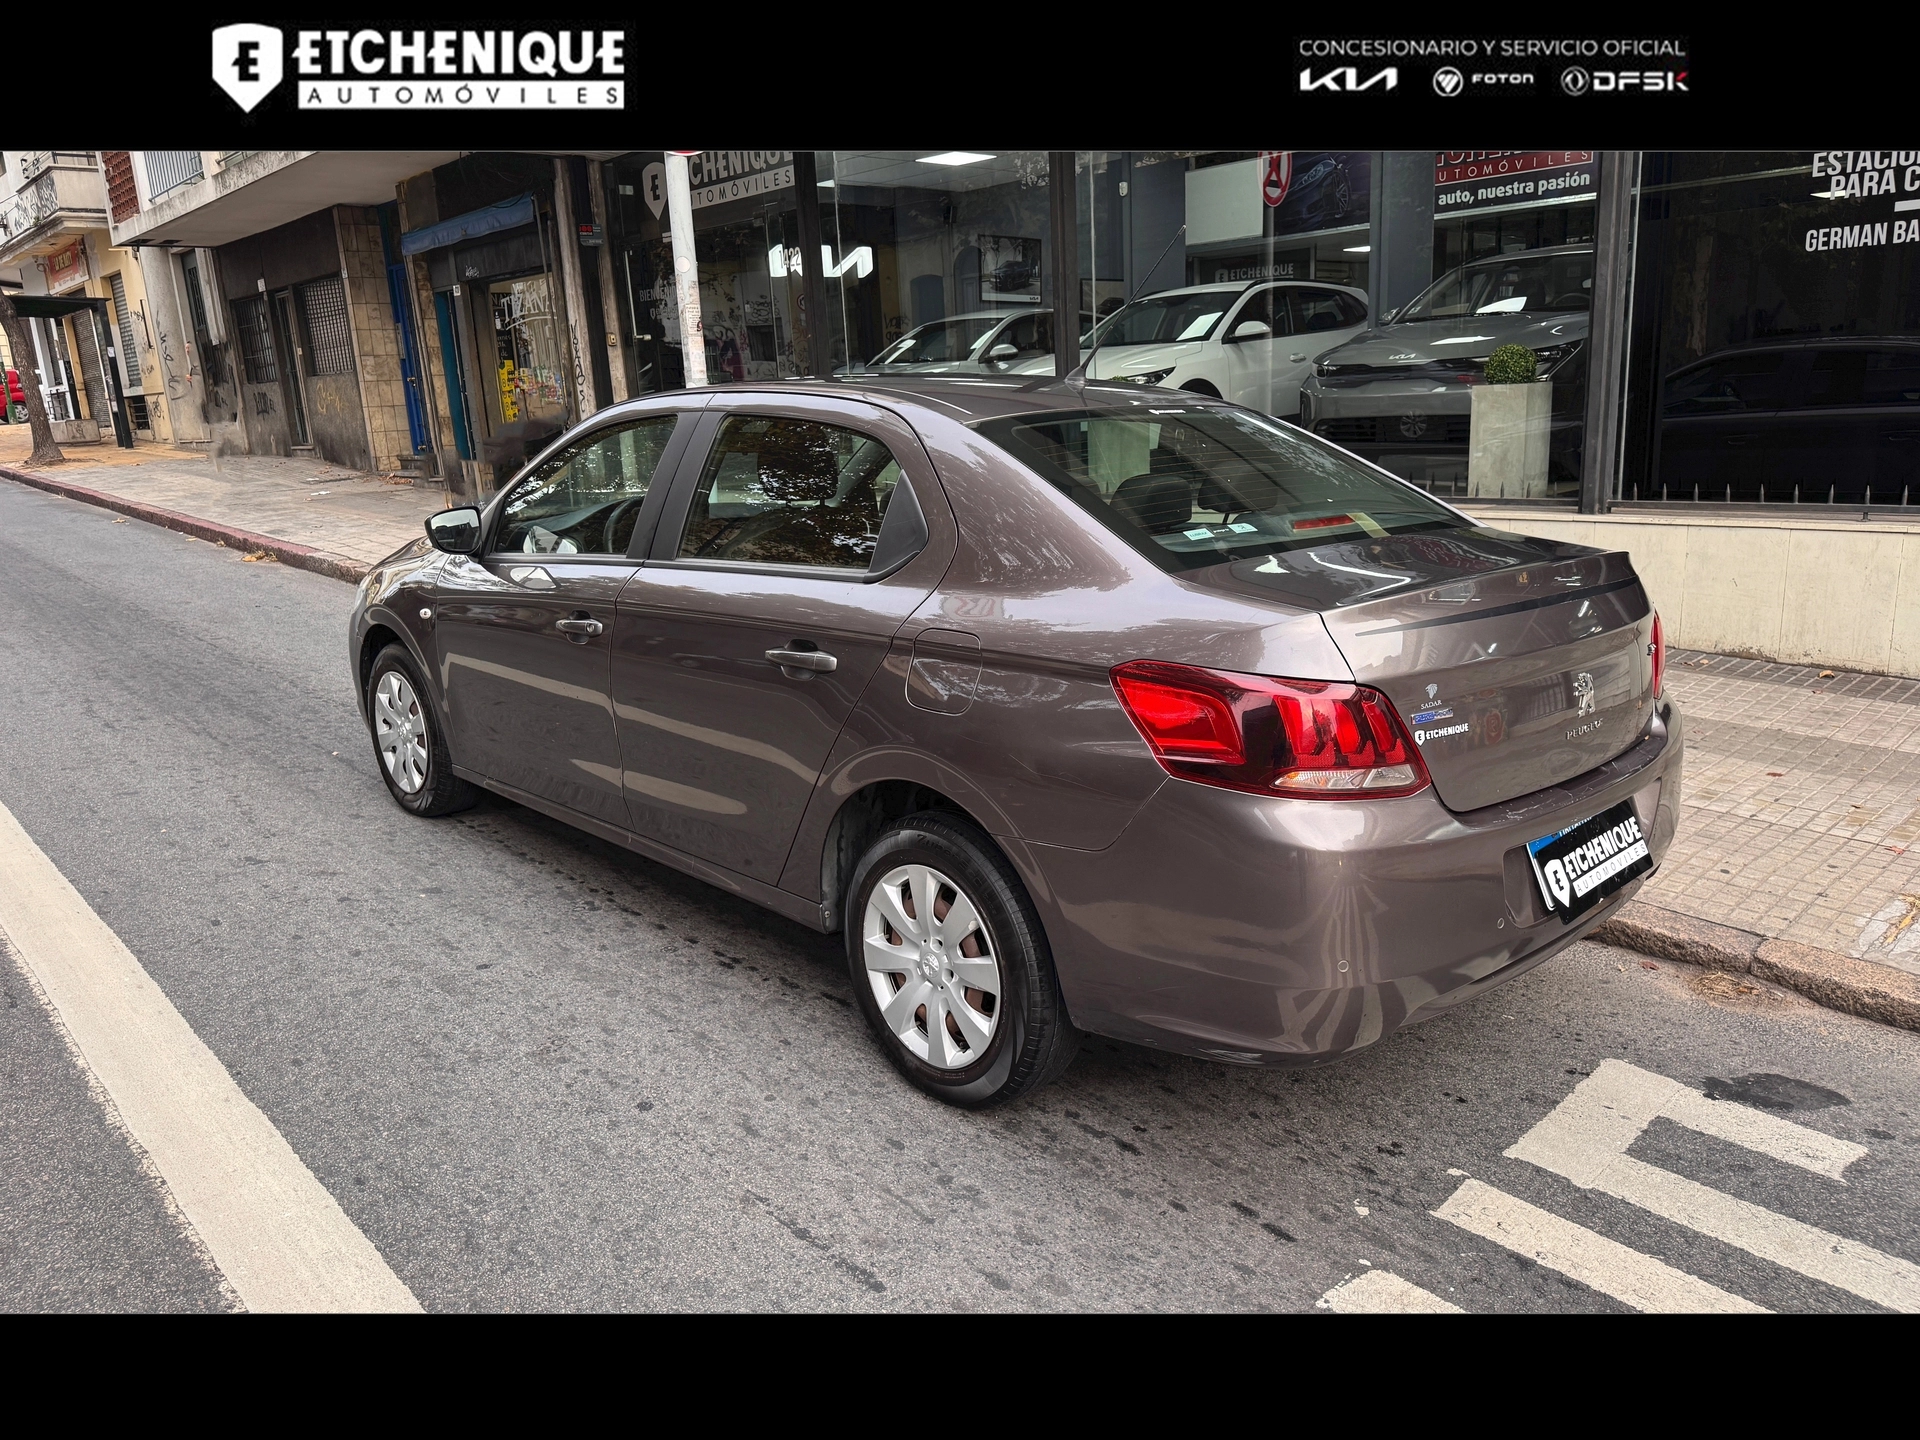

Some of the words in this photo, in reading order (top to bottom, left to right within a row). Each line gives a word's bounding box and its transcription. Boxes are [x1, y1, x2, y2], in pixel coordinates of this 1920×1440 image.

[1437, 151, 1589, 182] UTOMÓVILES
[1811, 151, 1920, 178] ESTACIO
[690, 169, 792, 206] TOMÓVILES
[1438, 189, 1475, 206] auto,
[1478, 181, 1535, 200] nuestra
[1538, 171, 1590, 196] pasión
[1829, 168, 1897, 200] PARA
[1805, 222, 1889, 252] GERMAN
[1229, 263, 1294, 280] ETCHENIQUE
[1420, 699, 1442, 710] SADAR
[1425, 722, 1469, 740] ETCHENIQUE
[1562, 815, 1643, 881] ETCHENIQUE
